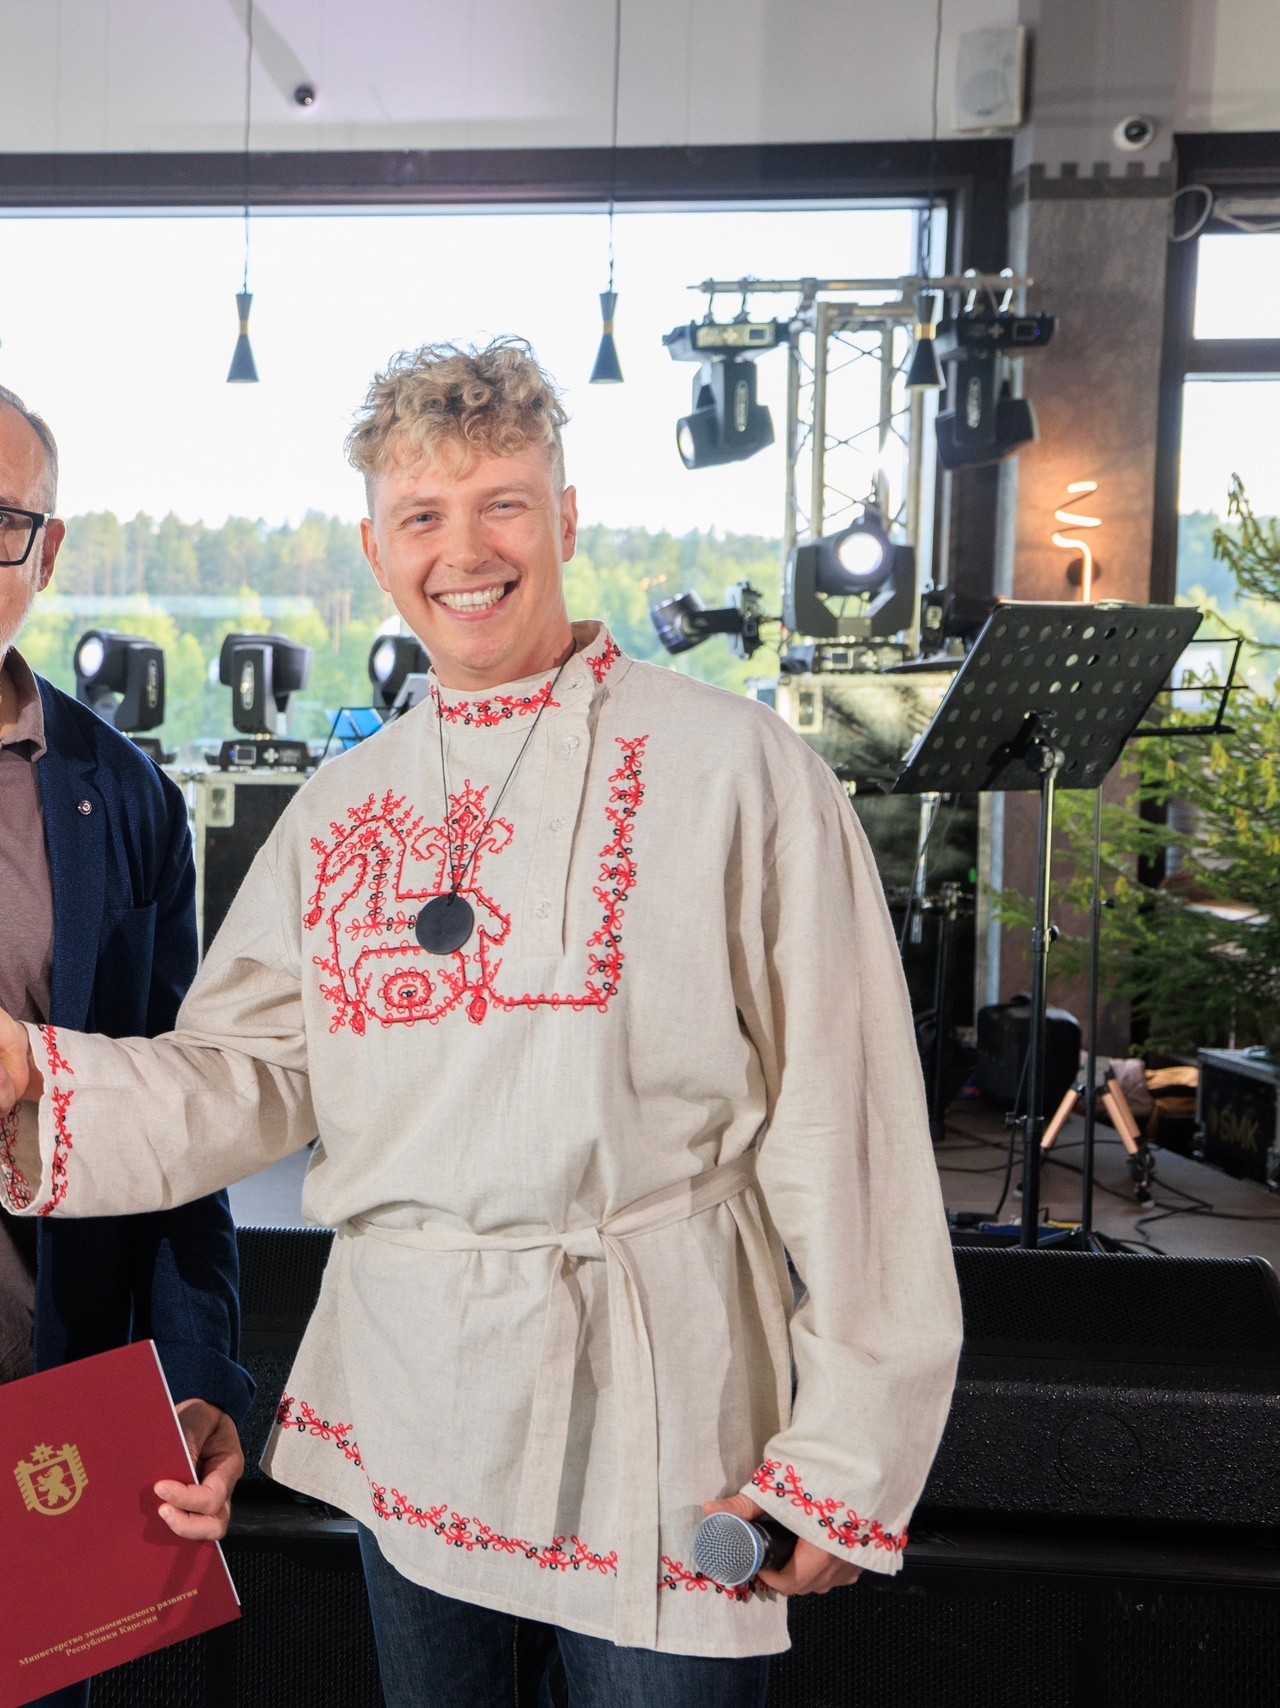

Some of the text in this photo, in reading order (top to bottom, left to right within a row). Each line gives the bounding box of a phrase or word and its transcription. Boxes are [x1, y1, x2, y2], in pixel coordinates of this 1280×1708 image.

[1220, 1108, 1260, 1153] SMK
[18, 1589, 198, 1667] Министерство экономического развития
[65, 1614, 158, 1657] Республики Карелия
